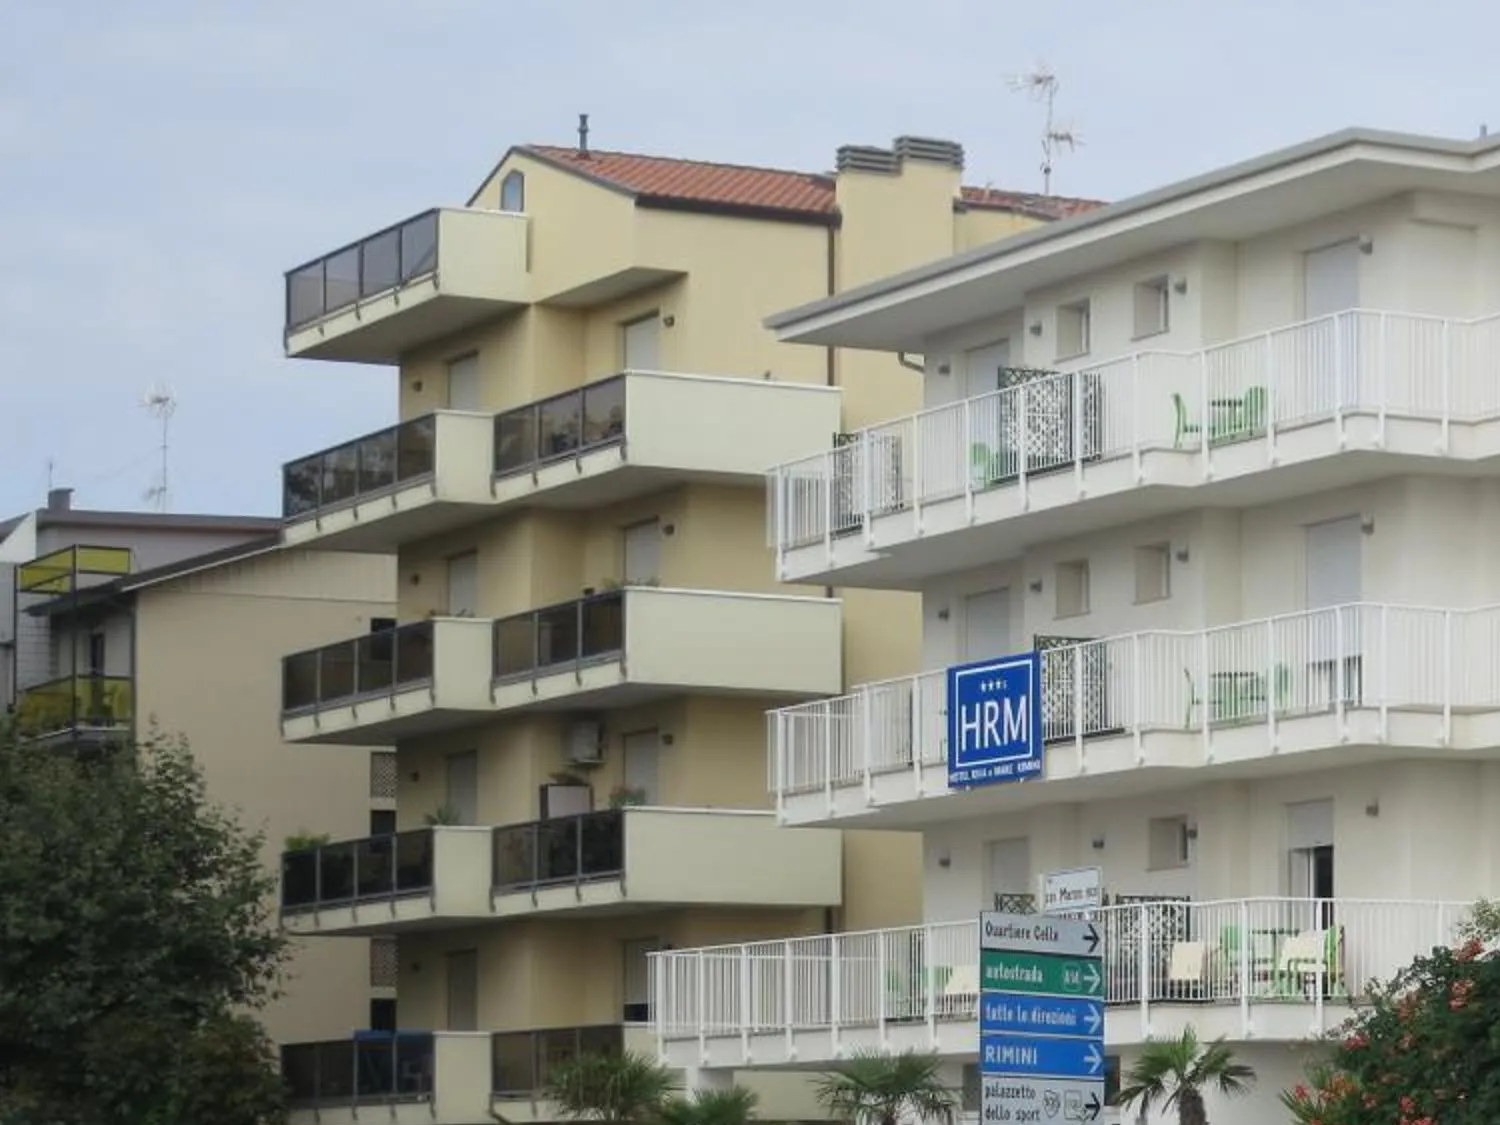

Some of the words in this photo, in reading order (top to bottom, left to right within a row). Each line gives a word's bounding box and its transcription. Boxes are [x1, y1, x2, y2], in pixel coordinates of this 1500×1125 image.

[961, 695, 1027, 752] HRM
[985, 960, 1043, 983] autostrada
[985, 1044, 1038, 1065] RIMINI
[985, 1081, 1037, 1100] palazzetto
[985, 1103, 1011, 1121] dello
[1015, 1106, 1041, 1124] sport
